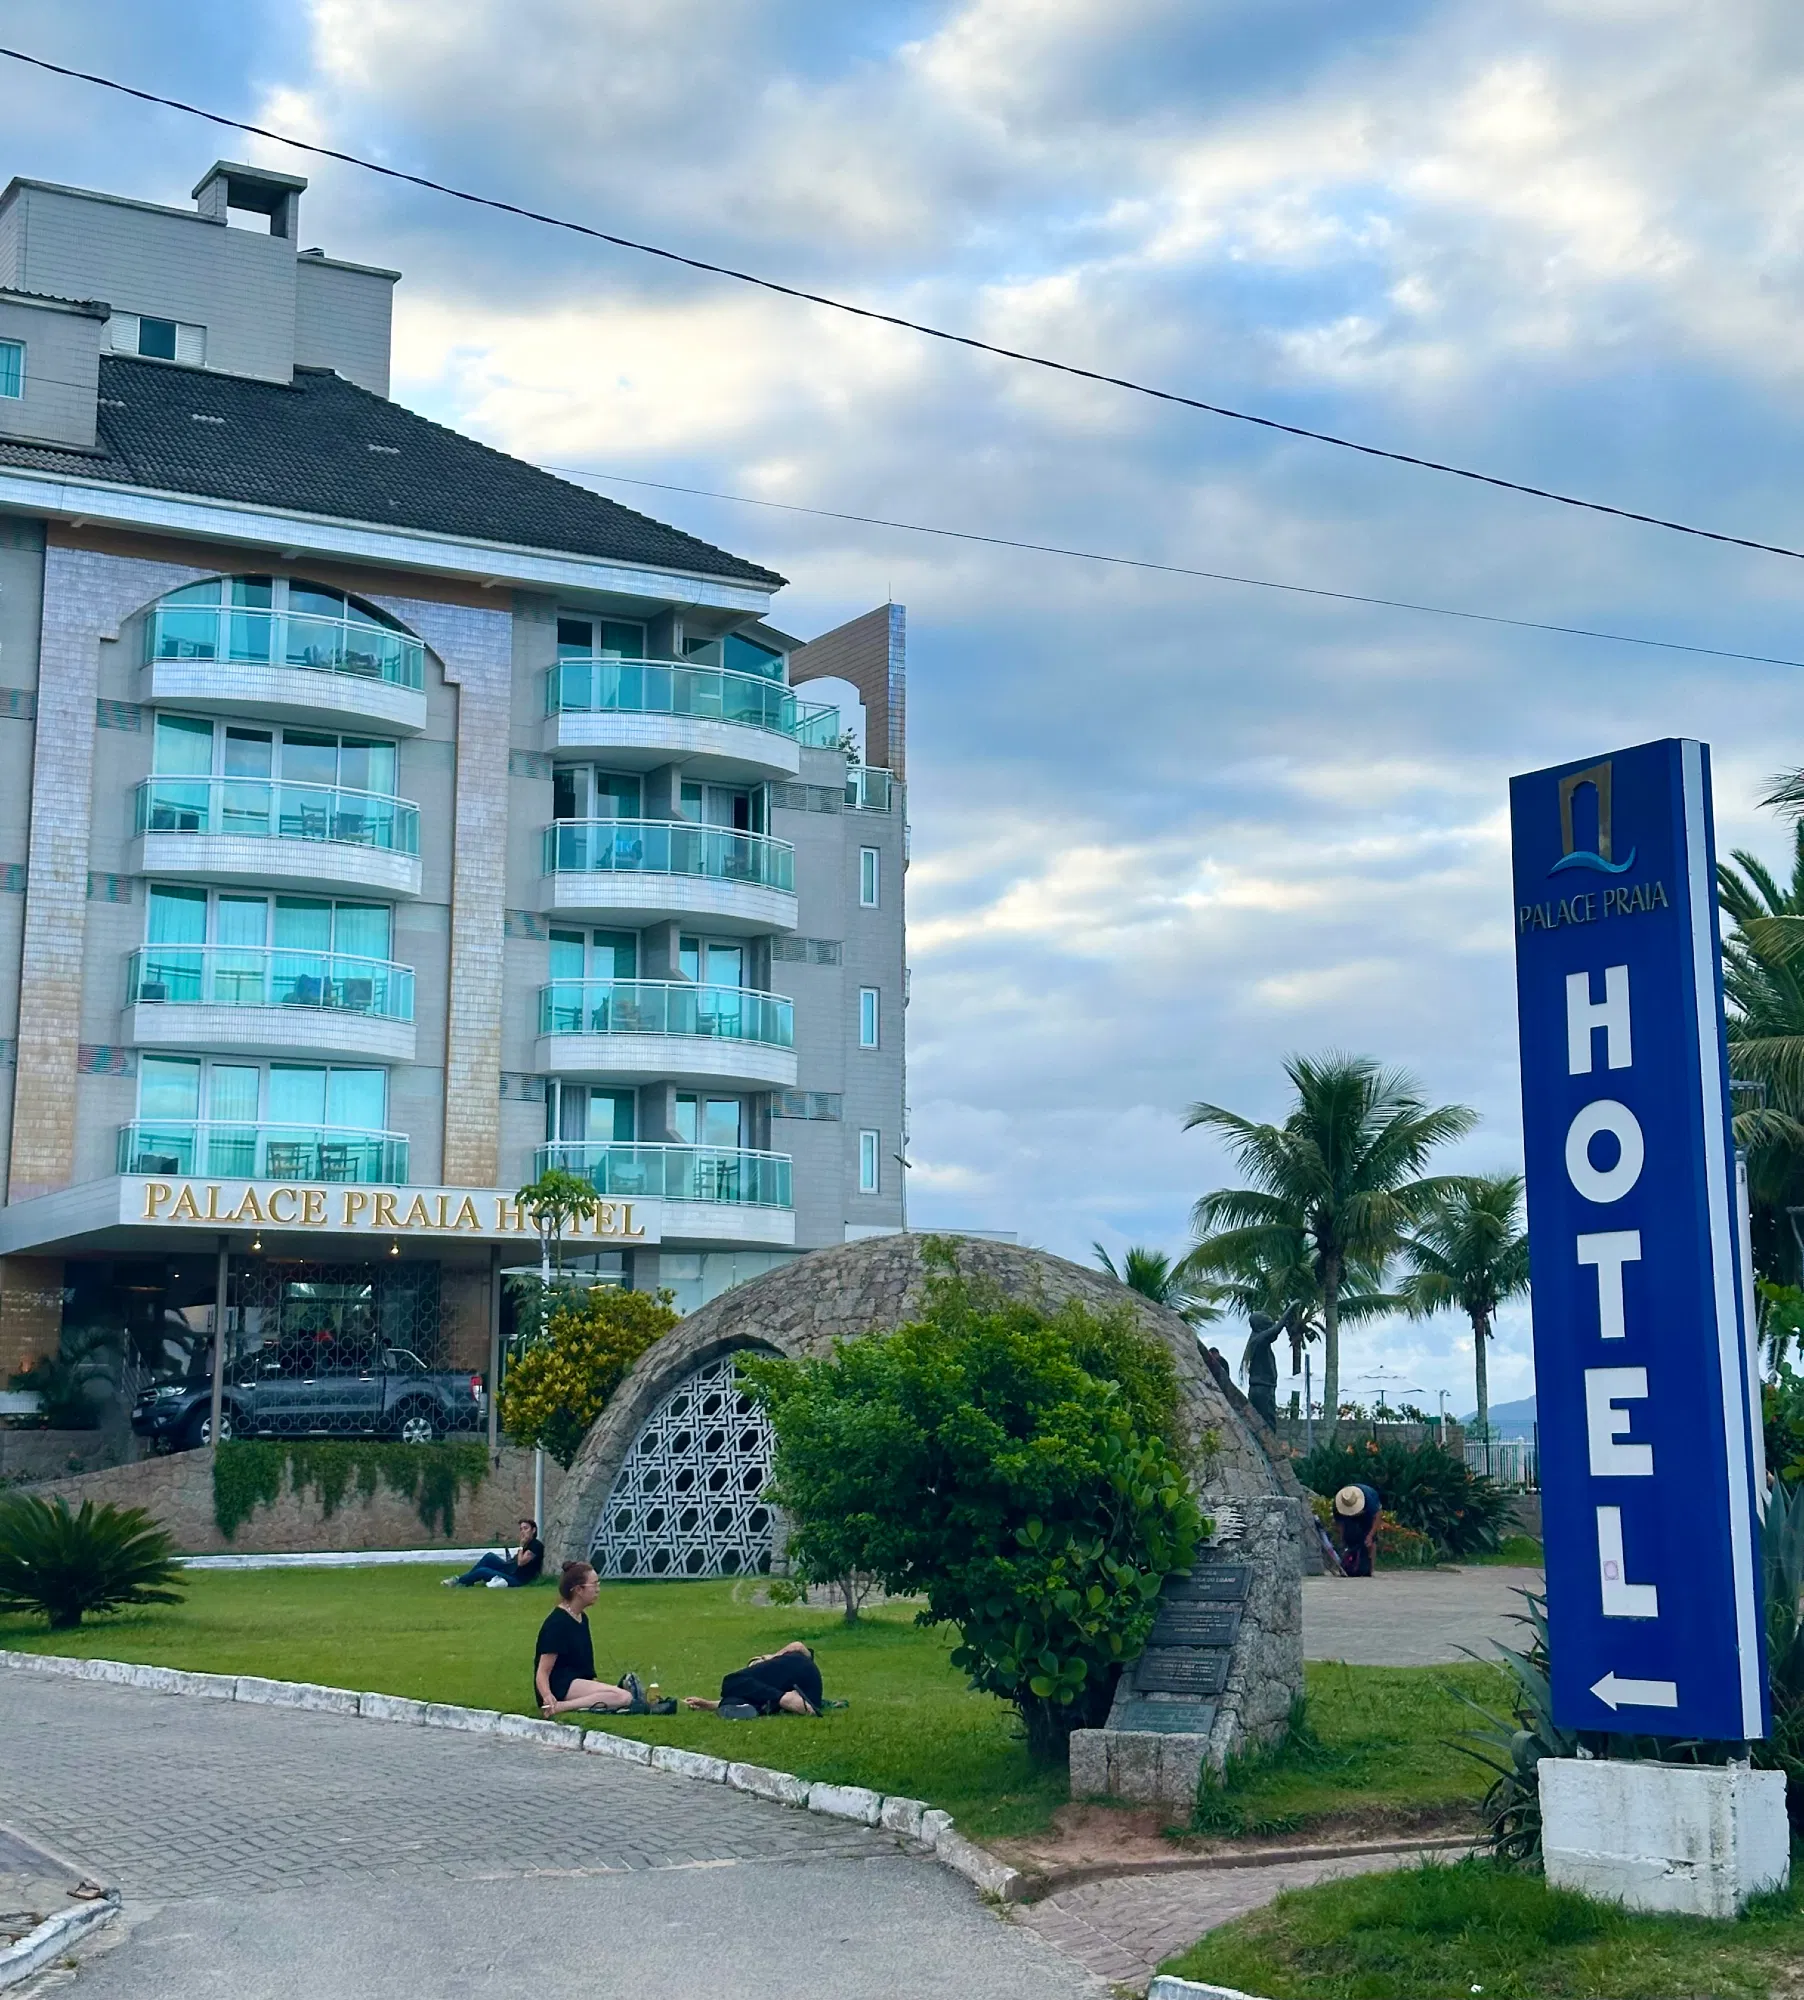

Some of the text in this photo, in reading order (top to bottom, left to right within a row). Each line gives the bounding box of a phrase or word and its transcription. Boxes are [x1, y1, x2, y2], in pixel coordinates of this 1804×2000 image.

[1519, 880, 1669, 934] PALACE PRAIA
[143, 1183, 329, 1226] PALACE
[341, 1191, 483, 1231] PRAIA
[1564, 963, 1659, 1619] HOTEL
